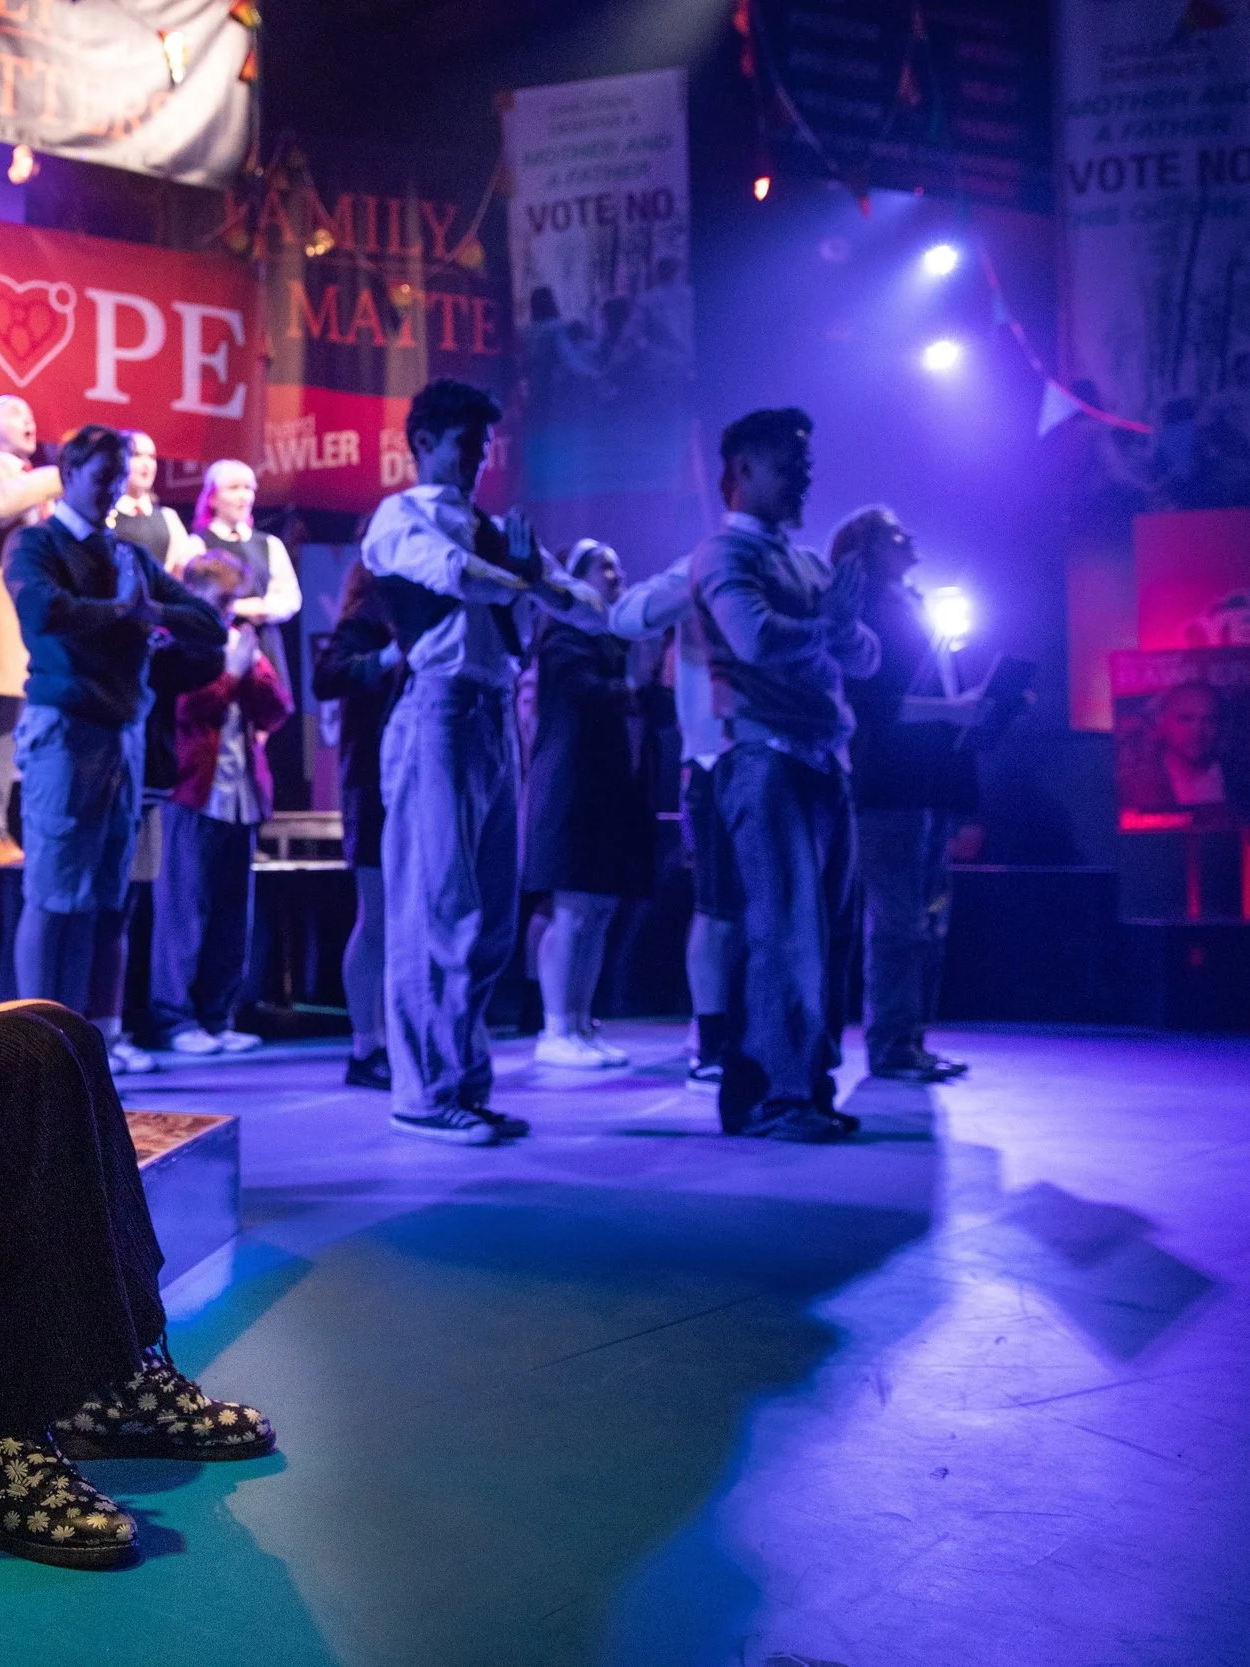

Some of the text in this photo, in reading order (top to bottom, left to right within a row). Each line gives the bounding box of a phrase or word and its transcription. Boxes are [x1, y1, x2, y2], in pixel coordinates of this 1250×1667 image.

[1067, 150, 1182, 195] VOTE
[1197, 144, 1250, 184] NO
[526, 187, 674, 234] VOTE NO
